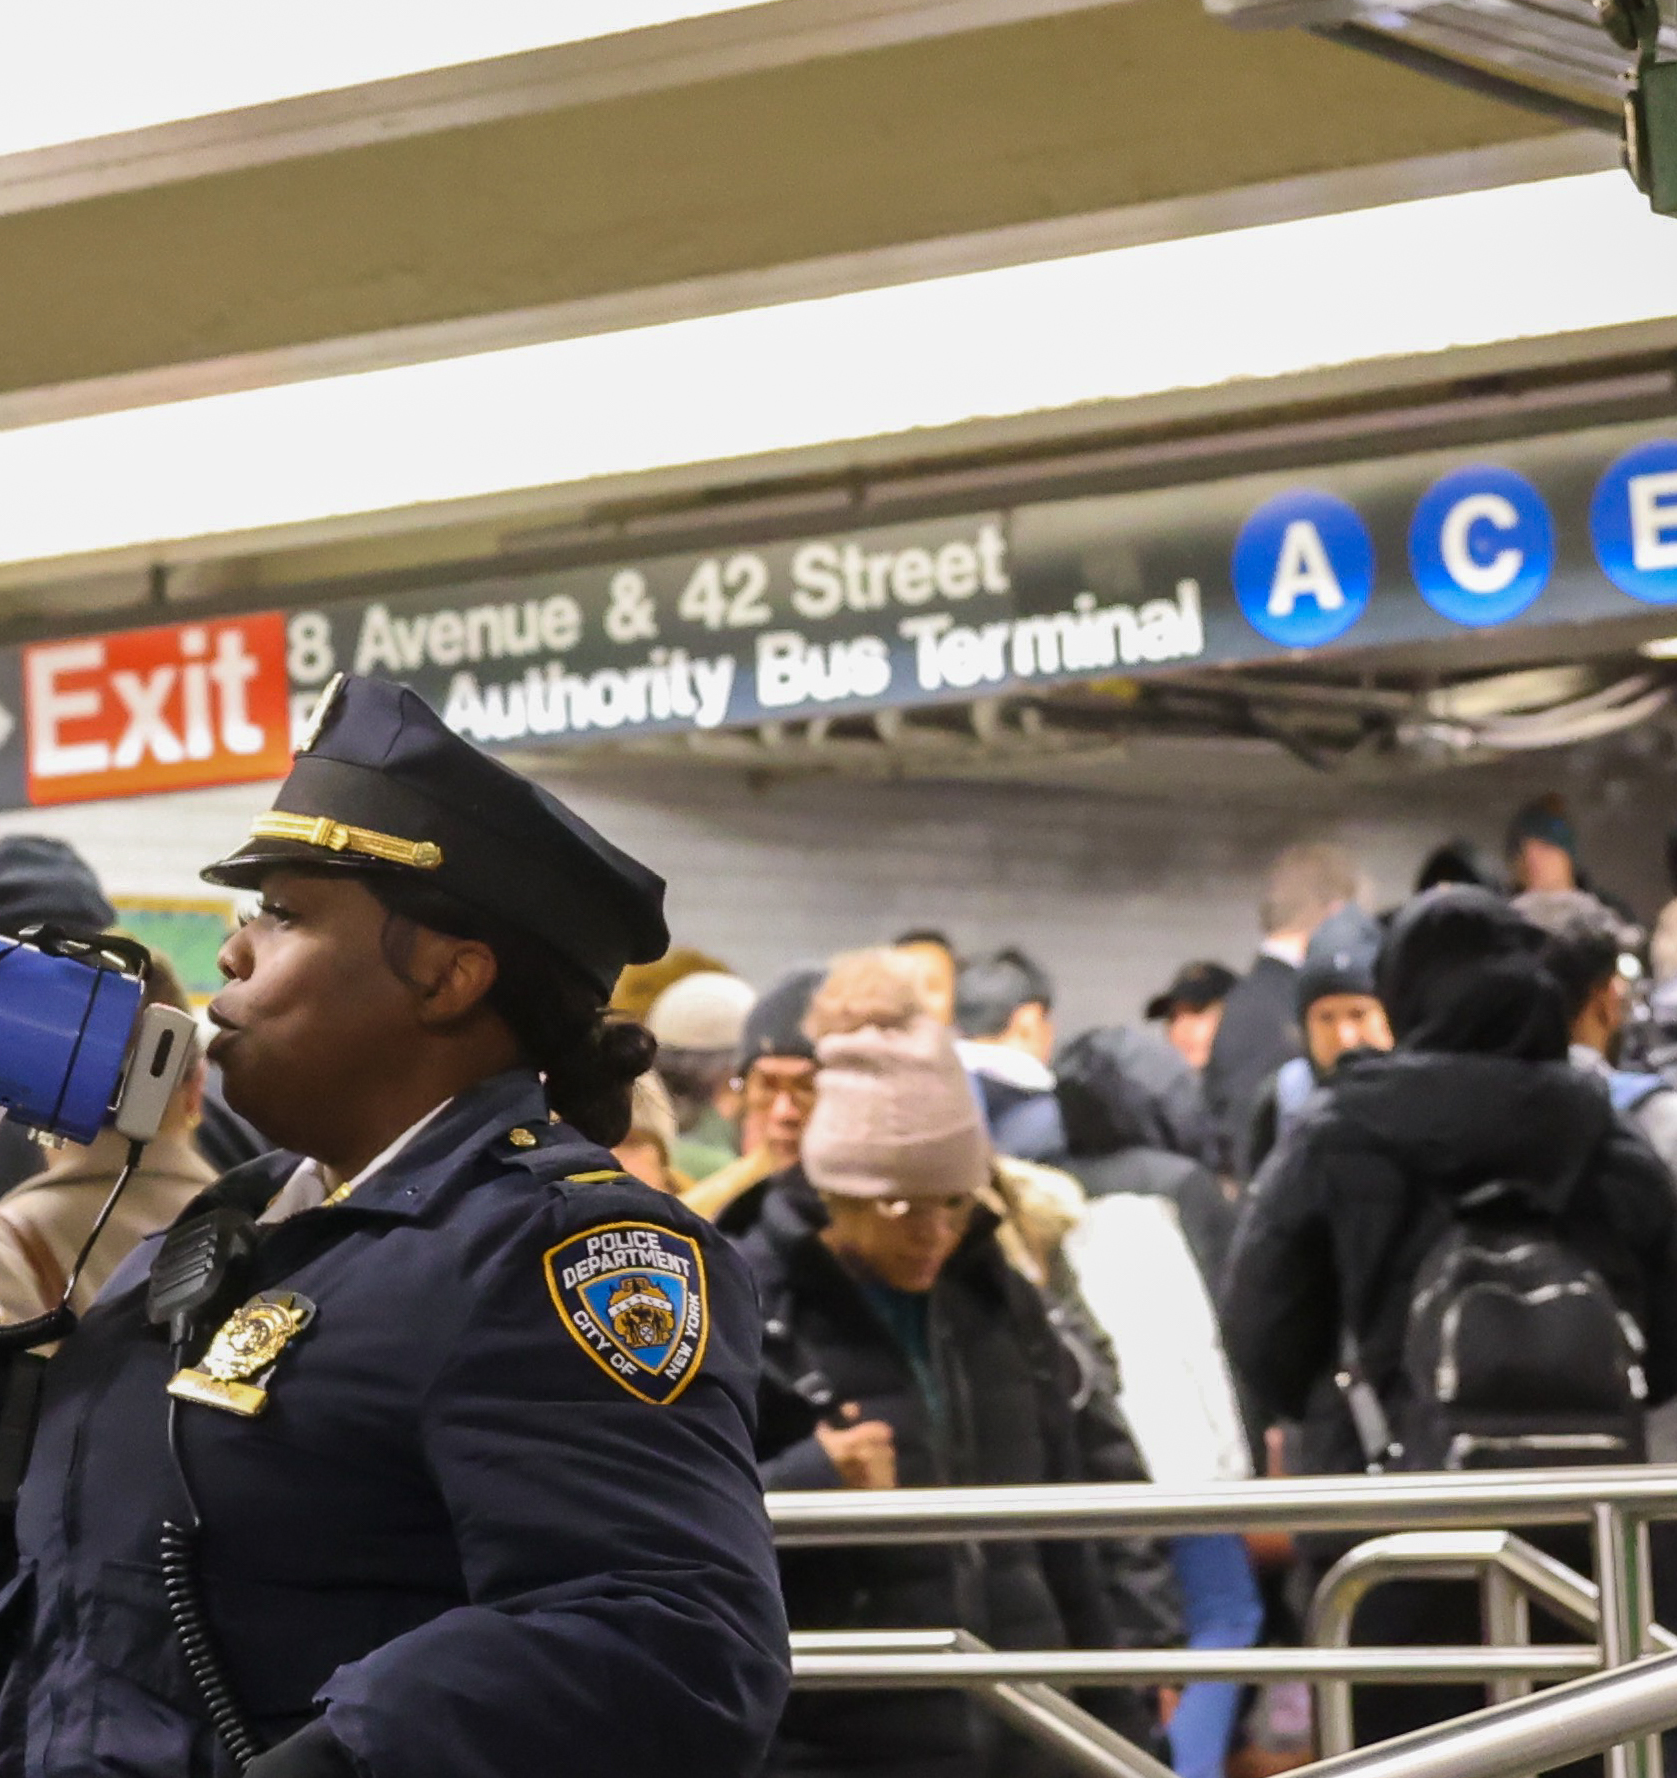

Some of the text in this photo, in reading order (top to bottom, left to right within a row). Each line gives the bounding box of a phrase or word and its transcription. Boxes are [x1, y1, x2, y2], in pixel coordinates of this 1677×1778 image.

[1267, 471, 1677, 617] A C E
[287, 523, 1010, 685] 8 Avenue & 42 Street
[442, 645, 736, 744] Authority
[754, 628, 892, 708] Bus
[897, 578, 1204, 691] Terminal
[25, 627, 265, 778] Exit
[562, 1249, 690, 1289] DEPARTMENT
[586, 1231, 661, 1255] POLICE
[573, 1310, 639, 1376] CITY OF
[665, 1291, 701, 1380] NEW YORK
